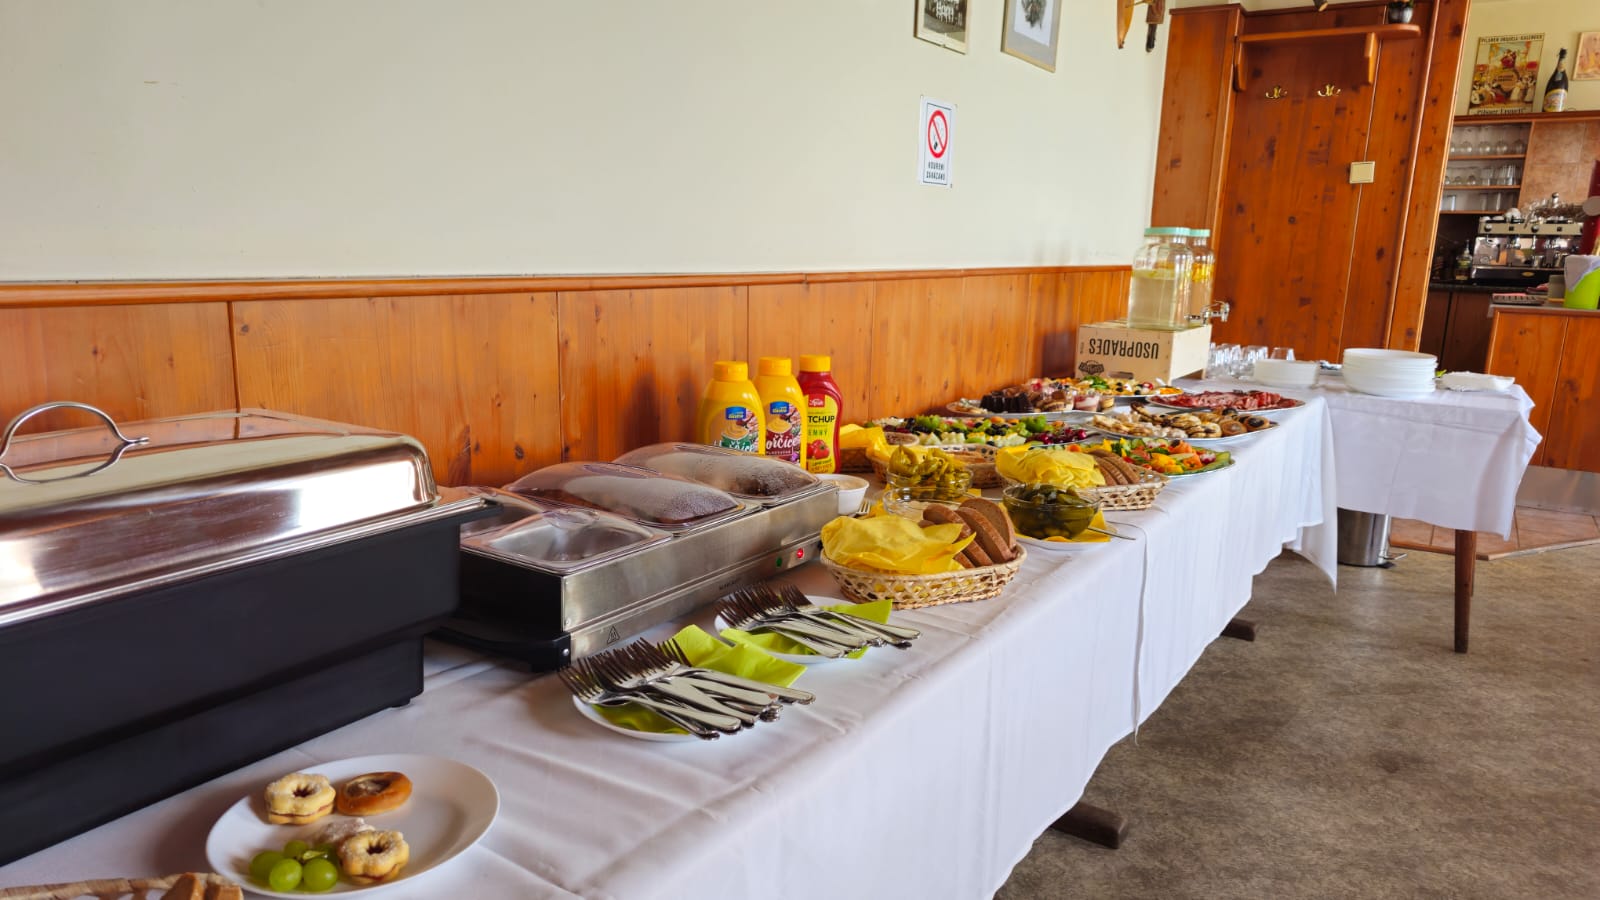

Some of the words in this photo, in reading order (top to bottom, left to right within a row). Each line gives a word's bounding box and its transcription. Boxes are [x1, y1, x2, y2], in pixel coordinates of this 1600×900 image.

[1089, 338, 1159, 360] USOPRADES
[808, 415, 835, 423] TCHUP
[766, 434, 801, 450] ořčice
